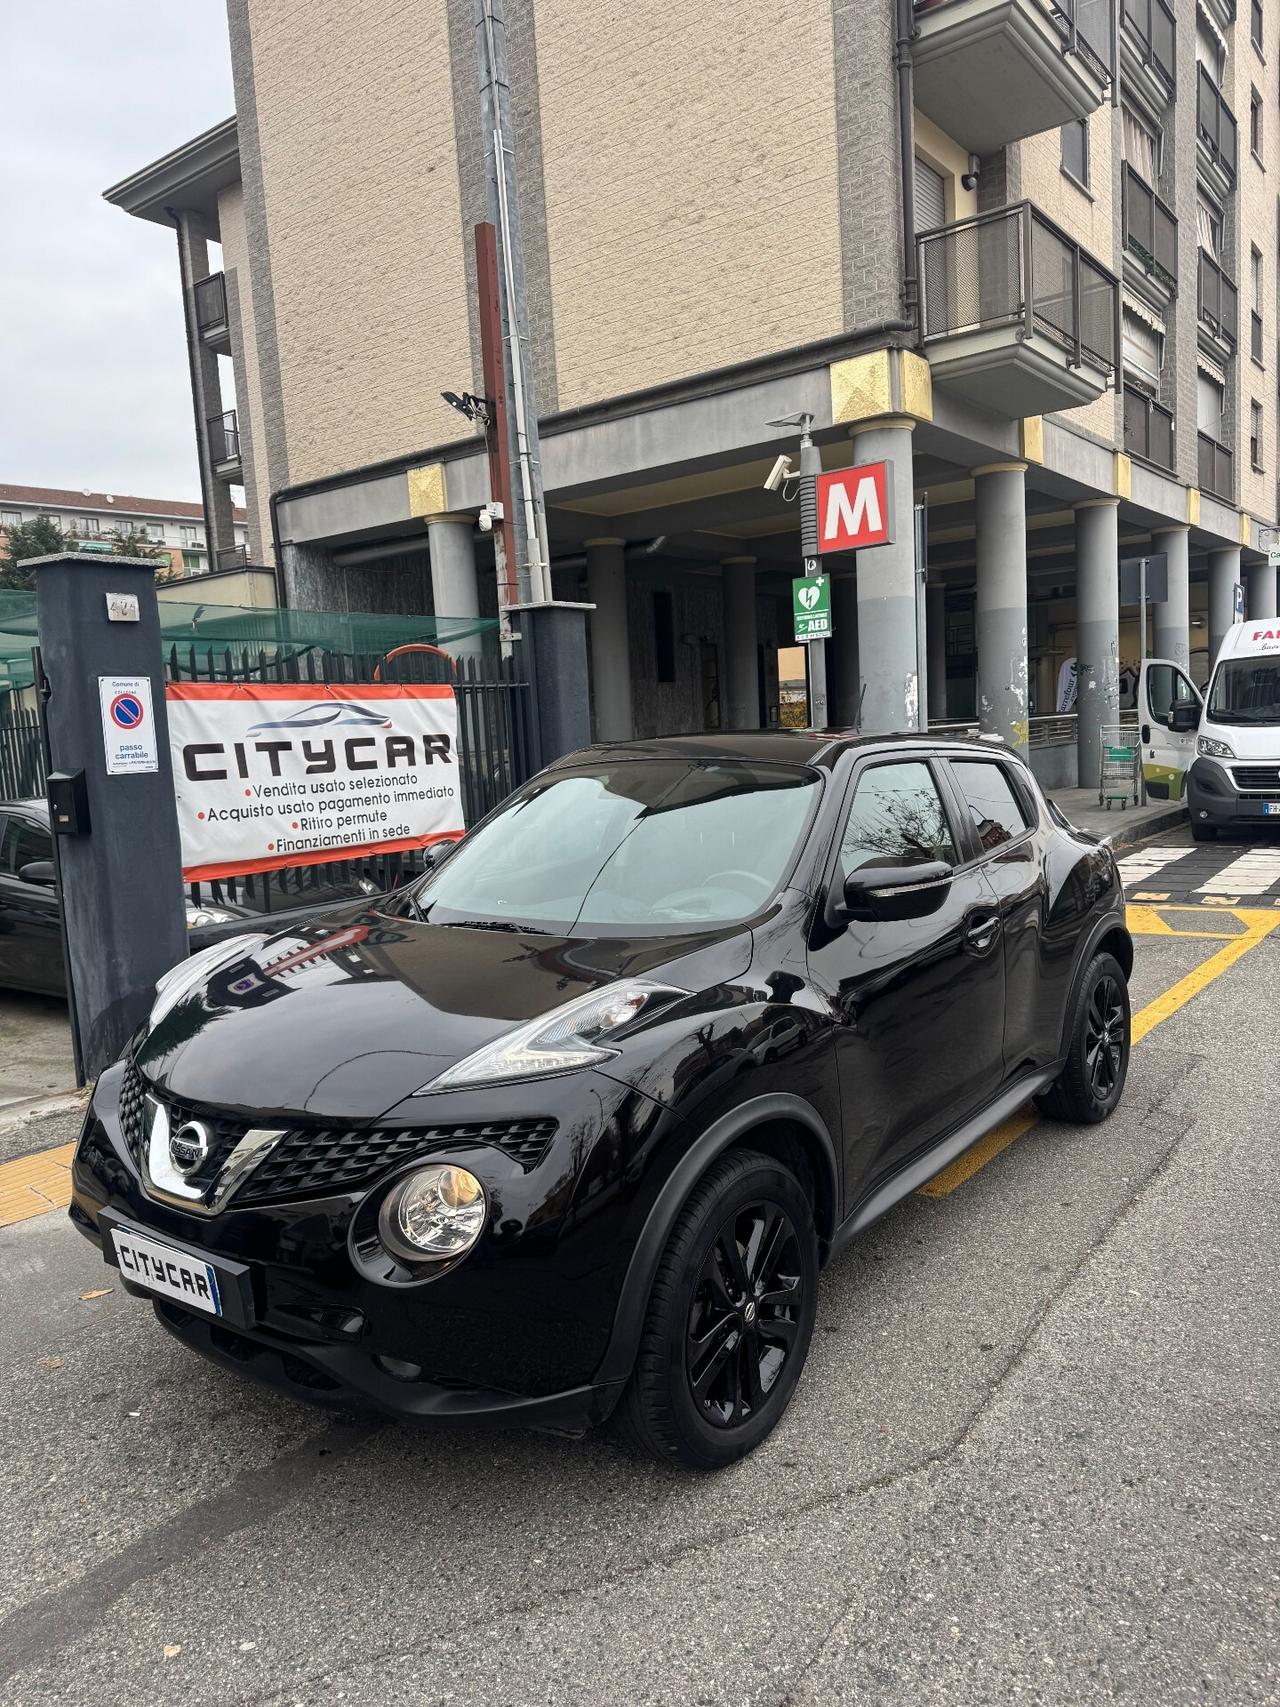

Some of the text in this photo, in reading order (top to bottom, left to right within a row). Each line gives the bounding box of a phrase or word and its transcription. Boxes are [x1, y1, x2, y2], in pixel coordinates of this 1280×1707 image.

[824, 476, 883, 540] M
[808, 618, 828, 632] AED
[134, 680, 140, 688] di
[115, 752, 149, 761] carrabile
[120, 744, 143, 753] passo
[183, 734, 453, 781] CITYCAR
[252, 773, 418, 798] Vendita usato selezionato
[207, 785, 455, 823] Acquisto usato pagamento immediato
[300, 810, 388, 831] Ritiro permute
[276, 823, 411, 853] Finanziamenti in sede
[119, 1244, 211, 1301] CITYCAR
